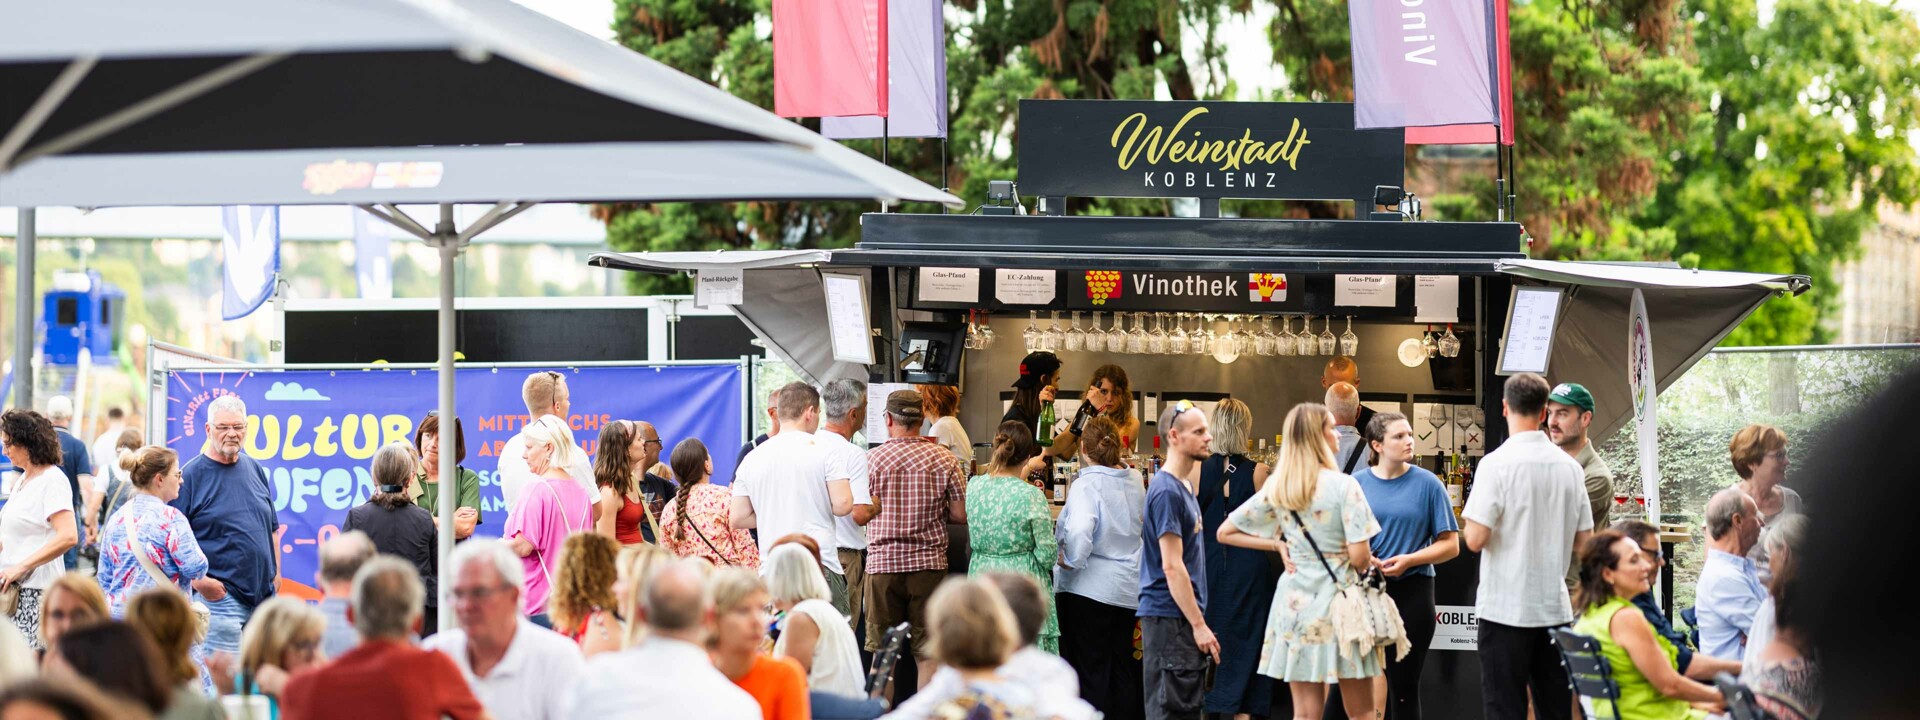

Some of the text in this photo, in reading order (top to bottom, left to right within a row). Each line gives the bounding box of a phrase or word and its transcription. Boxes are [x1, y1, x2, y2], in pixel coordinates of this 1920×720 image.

[1110, 106, 1311, 171] Weinstadt
[1144, 171, 1277, 188] KOBLENZ
[932, 271, 966, 279] Glas-Pfand
[1007, 274, 1045, 282] EC-Zahlung
[1132, 273, 1239, 297] Vinothek
[478, 414, 612, 432] MITTCHS
